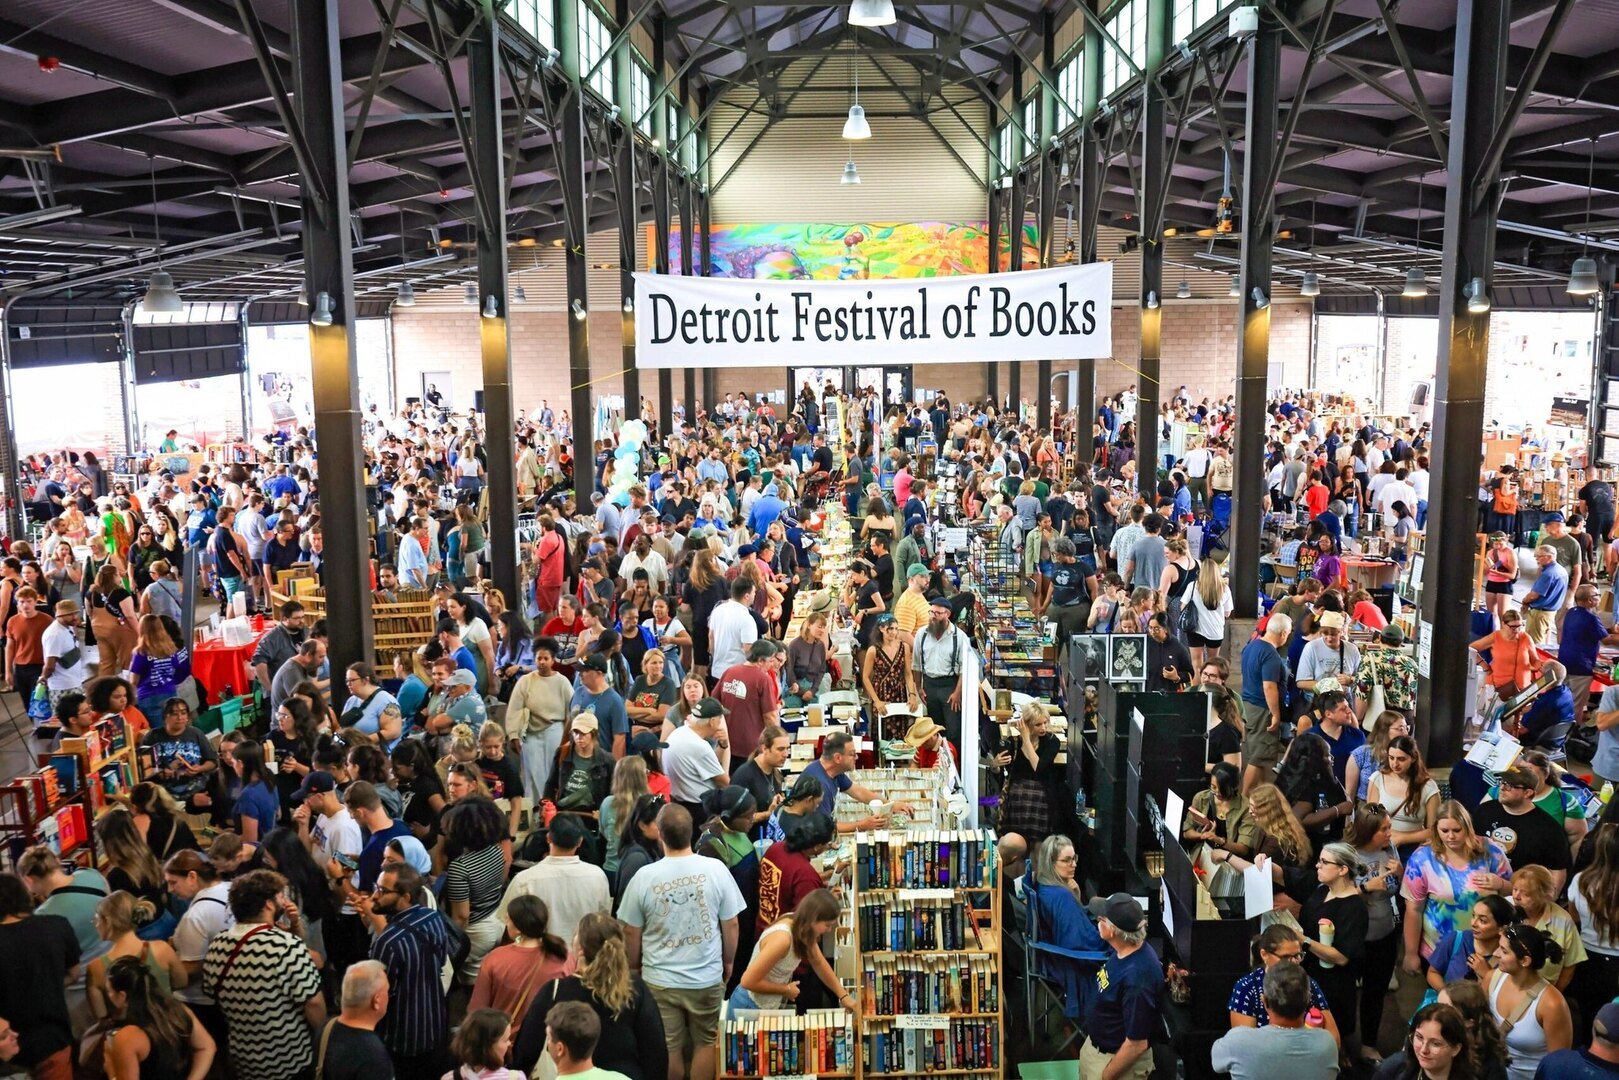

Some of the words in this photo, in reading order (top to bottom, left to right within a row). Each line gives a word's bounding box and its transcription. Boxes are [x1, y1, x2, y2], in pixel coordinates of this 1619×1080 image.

[648, 293, 780, 345] Detroit
[791, 288, 931, 342] Festival
[942, 286, 981, 338] of
[989, 283, 1096, 337] Books
